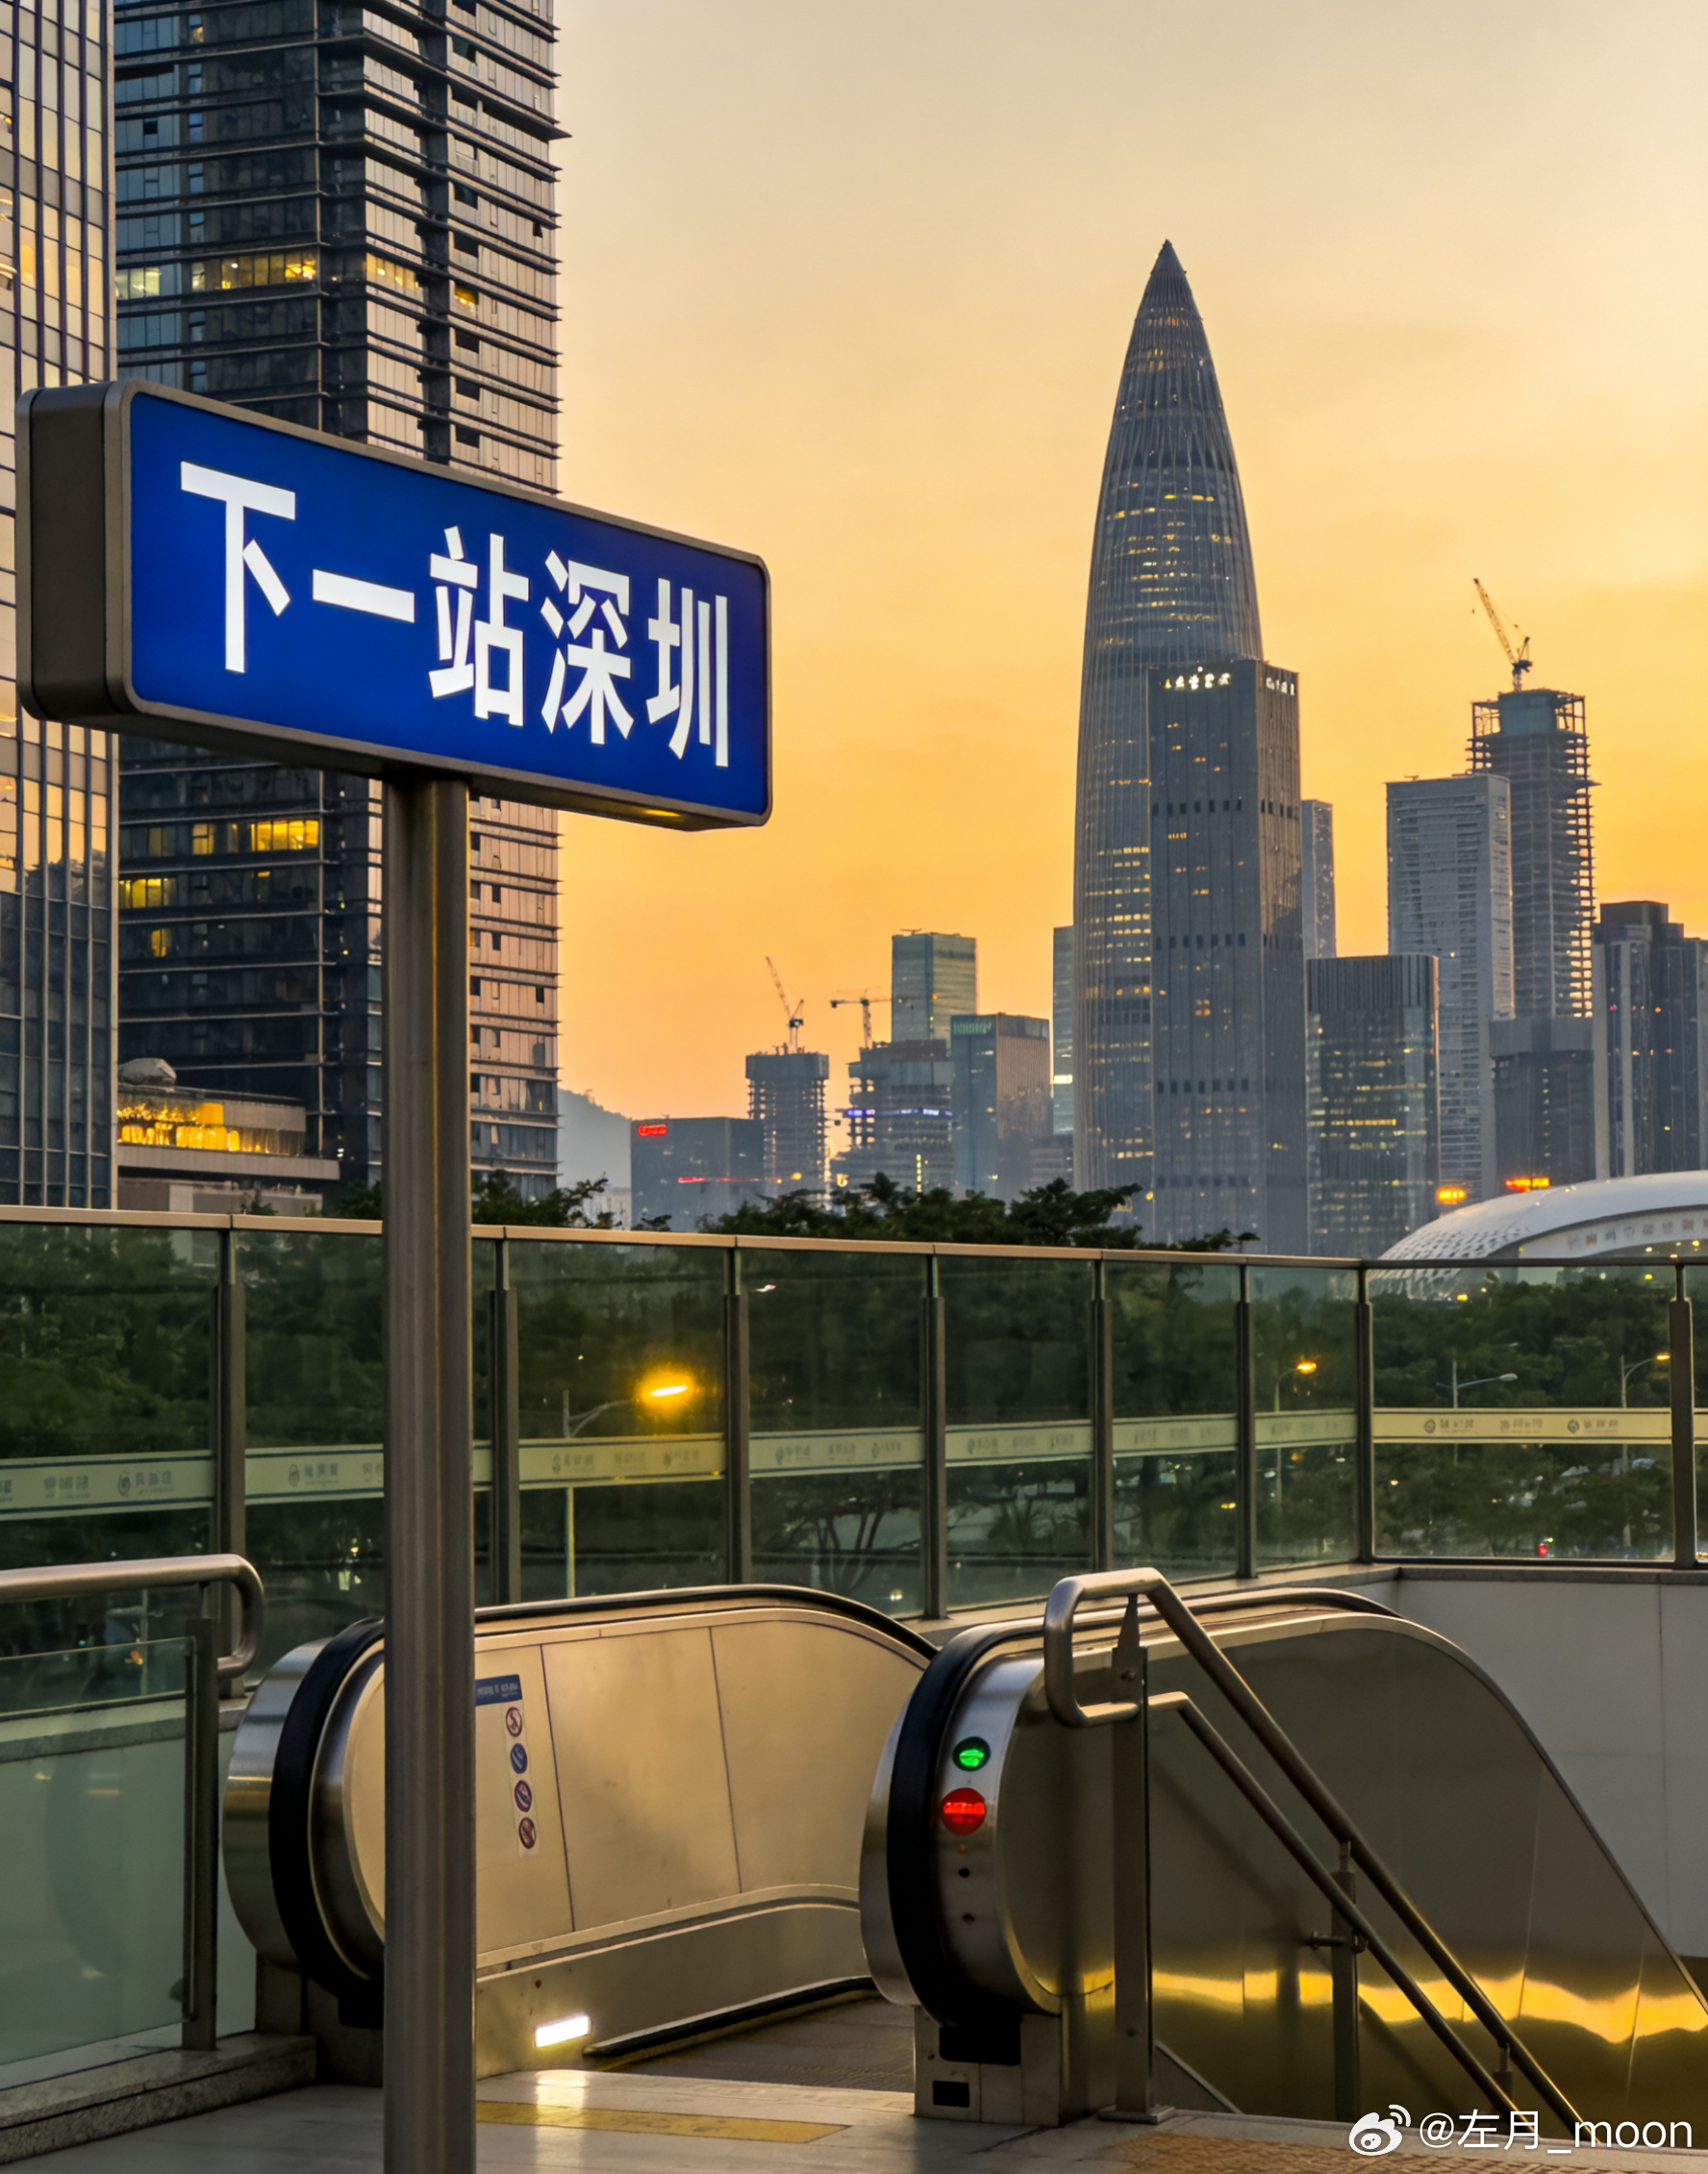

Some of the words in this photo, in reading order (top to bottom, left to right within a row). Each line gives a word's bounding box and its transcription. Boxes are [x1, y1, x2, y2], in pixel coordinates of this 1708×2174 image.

[180, 461, 729, 768] 下一站深圳
